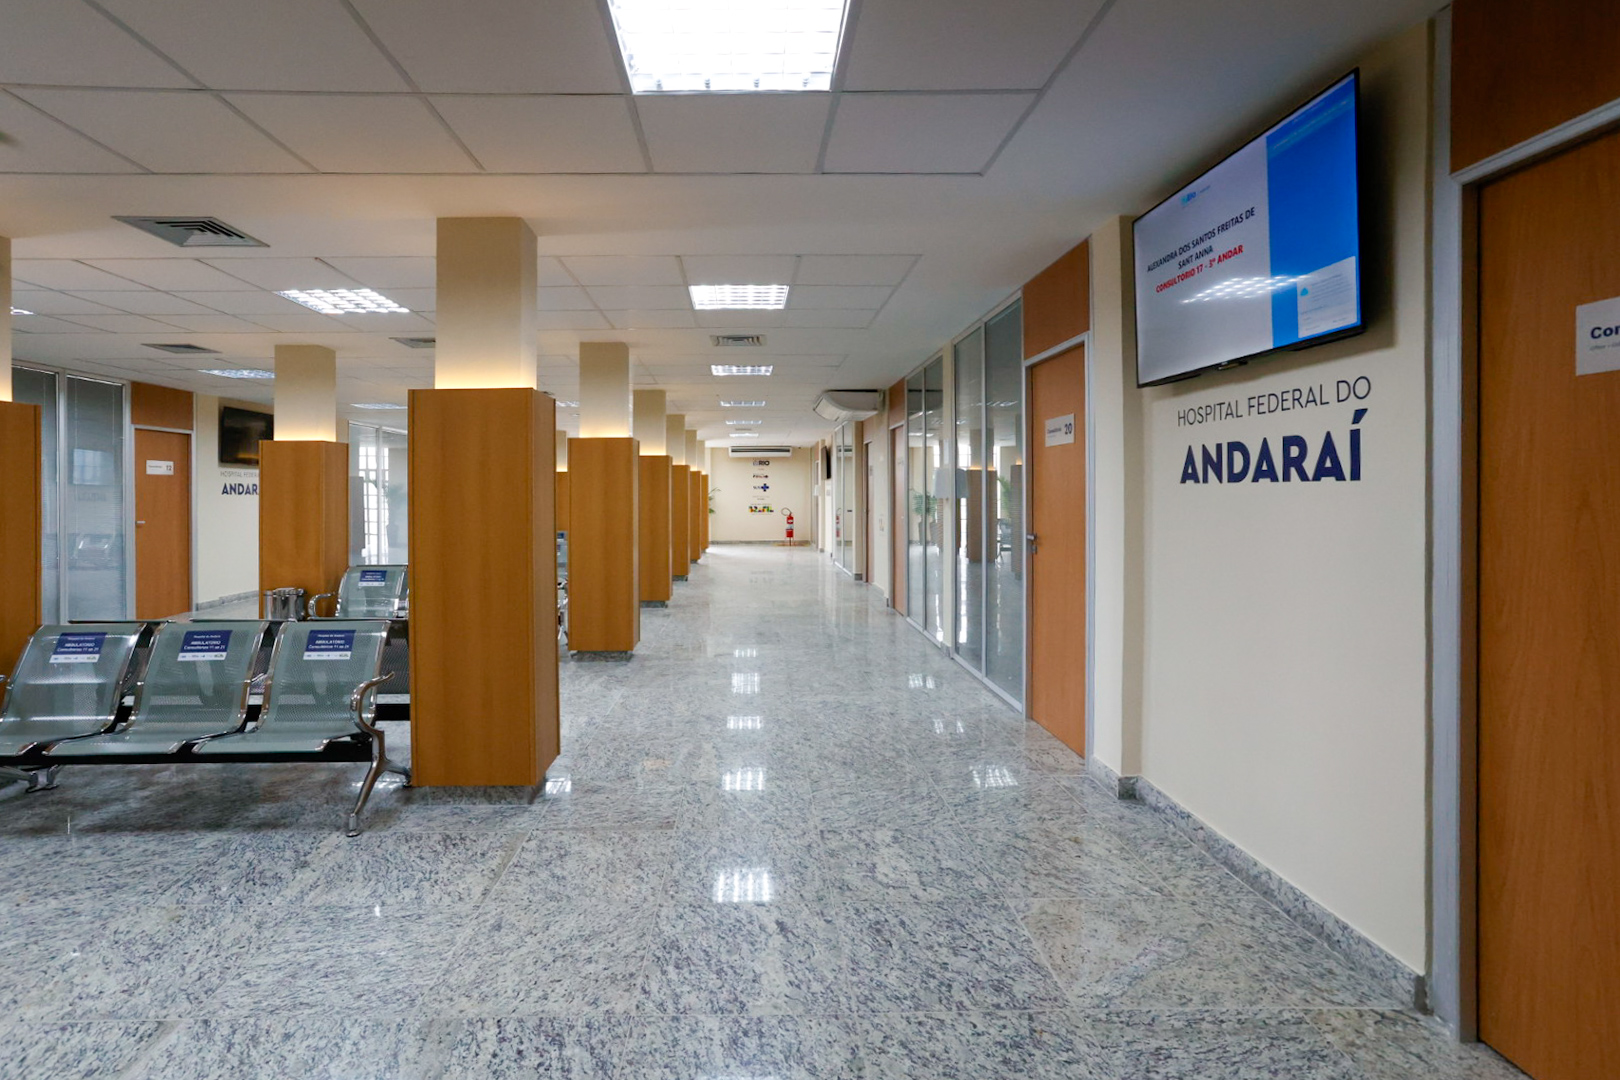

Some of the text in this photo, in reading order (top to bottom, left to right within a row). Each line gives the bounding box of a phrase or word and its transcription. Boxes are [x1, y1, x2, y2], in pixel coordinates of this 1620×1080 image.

[1147, 206, 1255, 273] ALEXANDRA DOS SANTOS FREITAS DE
[1178, 245, 1214, 270] SANT ANNA
[1155, 268, 1196, 293] CONSULTORIO
[1196, 264, 1204, 274] 17
[1217, 244, 1244, 264] ANDAR
[1177, 375, 1371, 427] HOSPITAL FEDERAL DO
[1064, 422, 1073, 435] 20
[1180, 408, 1368, 484] ANDARAÍ
[221, 482, 259, 496] ANDAR
